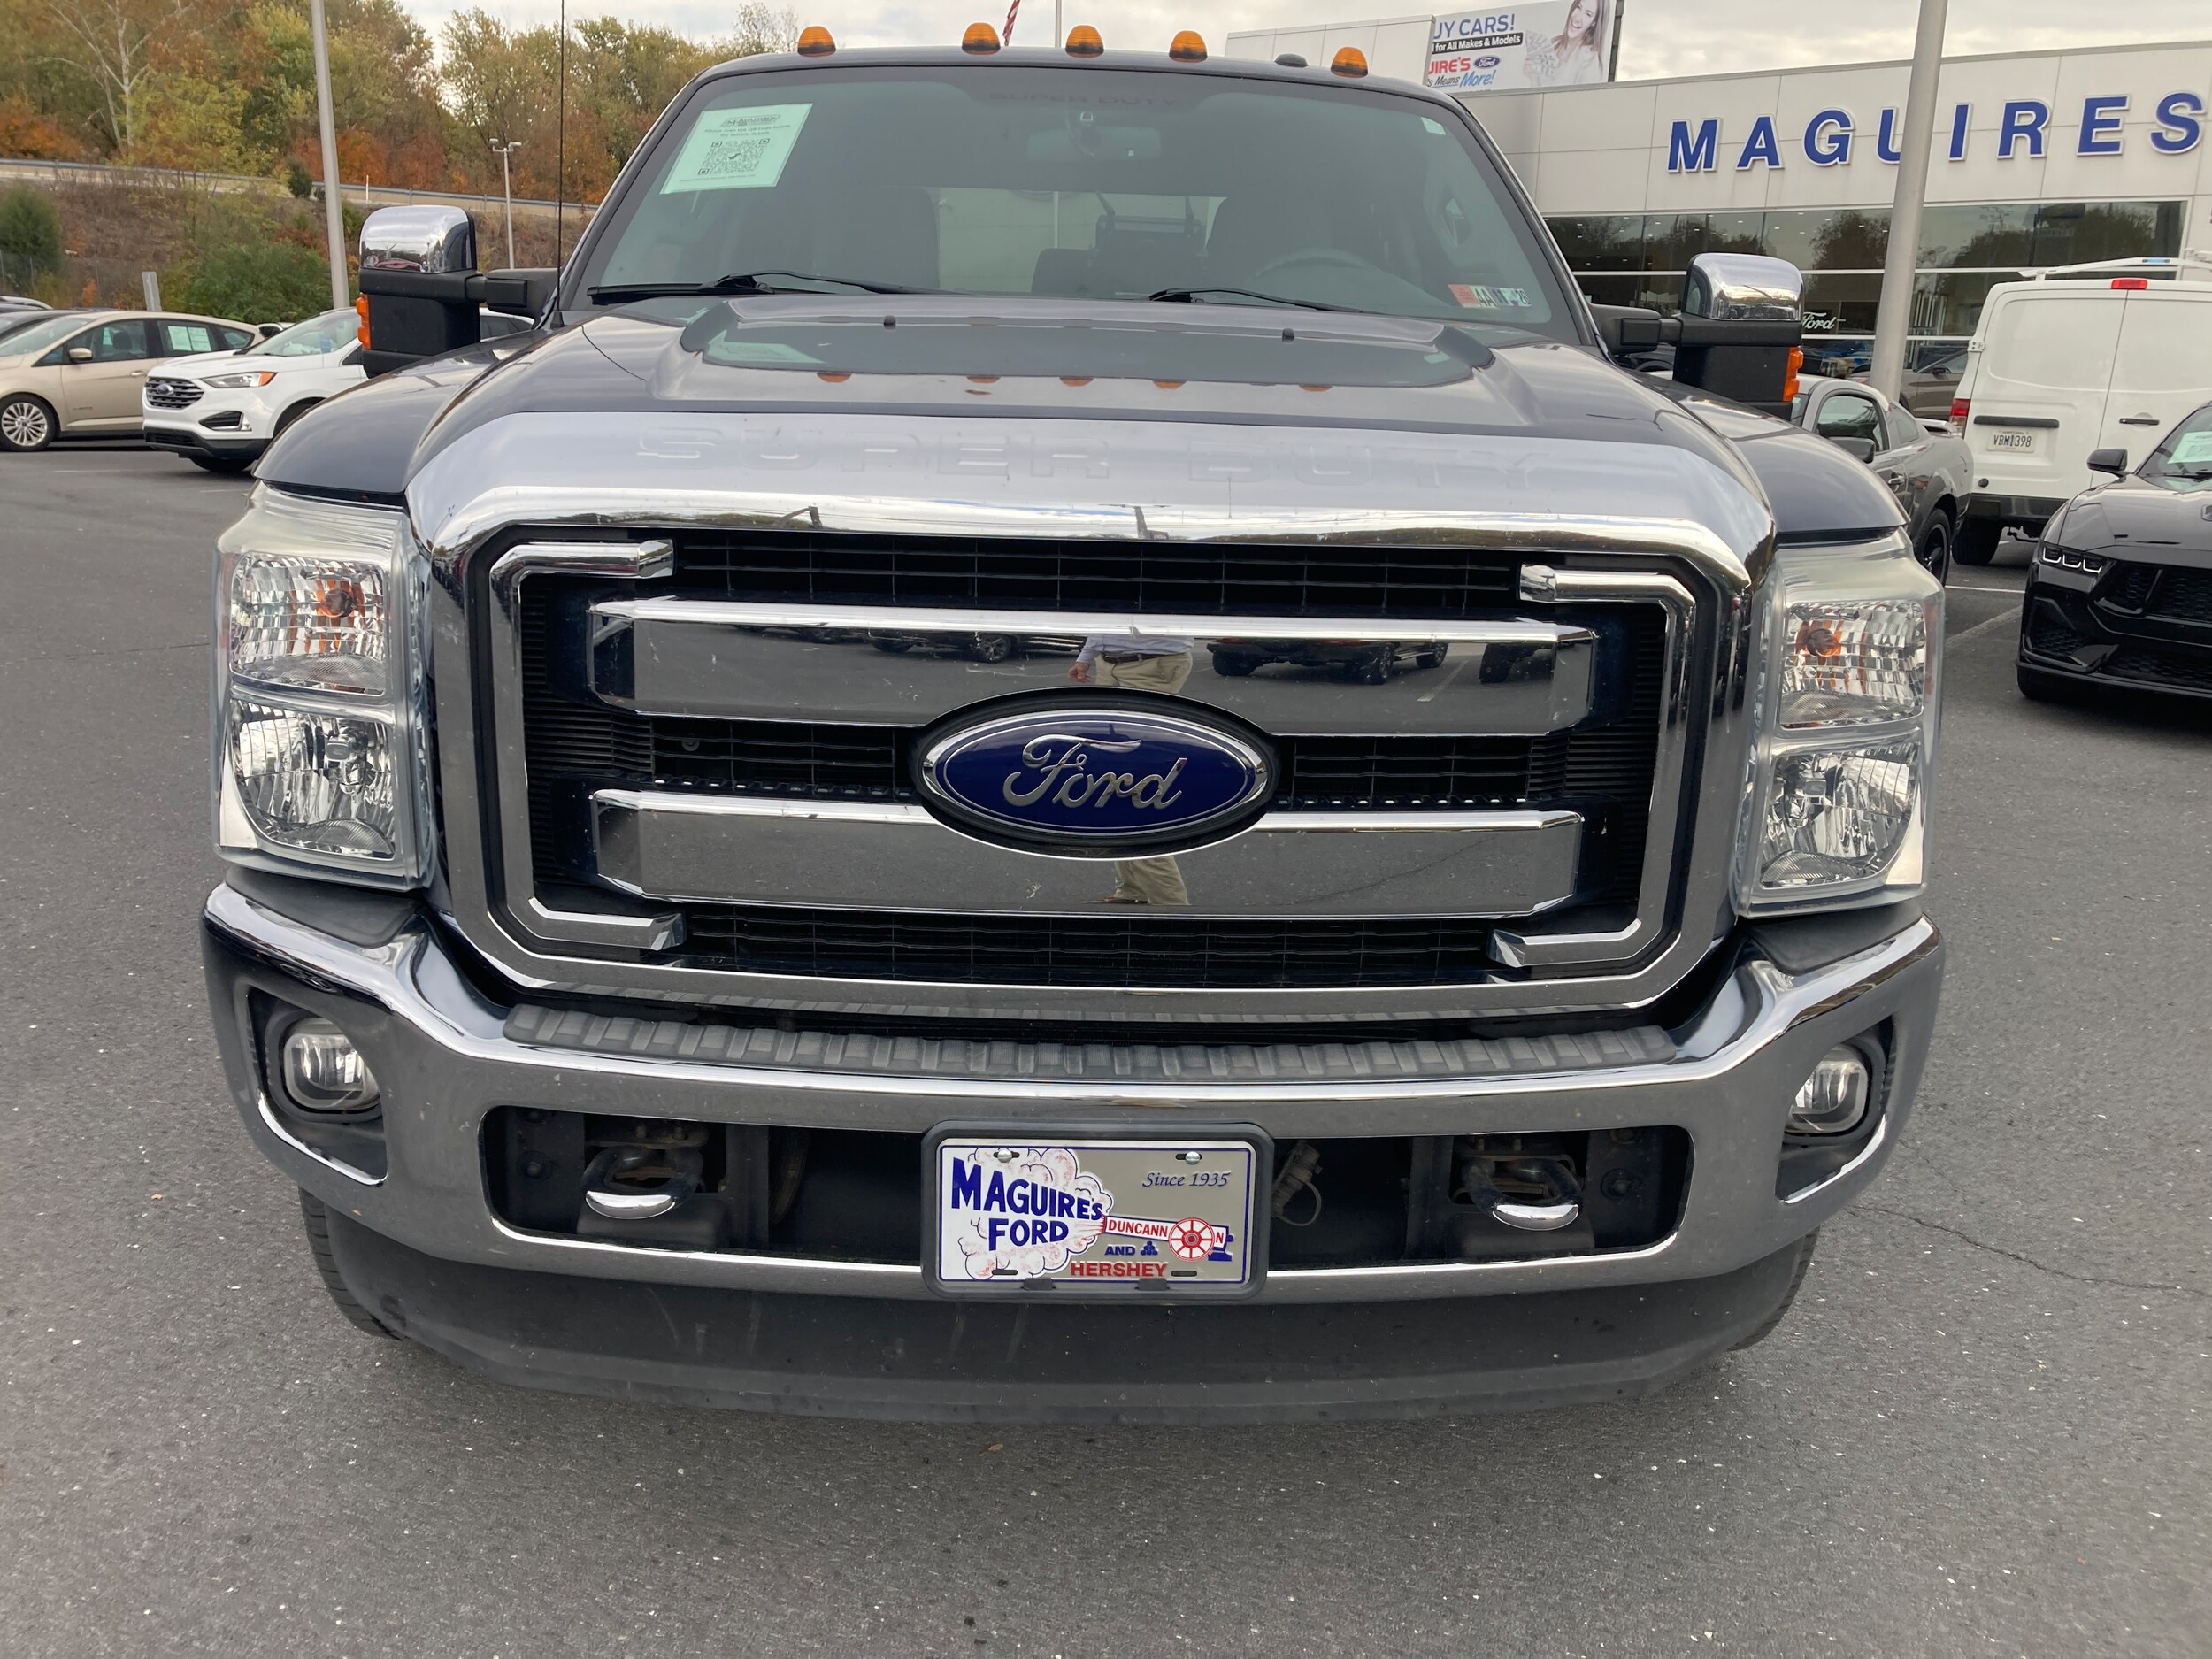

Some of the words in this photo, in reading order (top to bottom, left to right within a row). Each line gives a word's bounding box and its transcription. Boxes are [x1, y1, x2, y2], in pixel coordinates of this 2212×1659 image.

[1459, 13, 1515, 36] CARS!
[1435, 42, 1446, 51] for
[1447, 40, 1458, 50] All
[1458, 38, 1483, 49] Makes
[1491, 35, 1521, 44] Models
[1434, 75, 1461, 86] Means
[1459, 69, 1497, 88] More!
[1667, 91, 2203, 173] MAGUIRES
[1801, 311, 1839, 330] Ford
[635, 426, 1110, 479] SUPER
[1187, 441, 1550, 488] DUTY
[1002, 733, 1188, 809] Ford
[950, 1156, 1103, 1221] MAGUIRE'S
[1141, 1172, 1186, 1188] Since
[1188, 1171, 1232, 1187] 1935
[988, 1217, 1070, 1252] FORD
[1104, 1245, 1136, 1256] AND
[1070, 1261, 1169, 1278] HERSHEY
